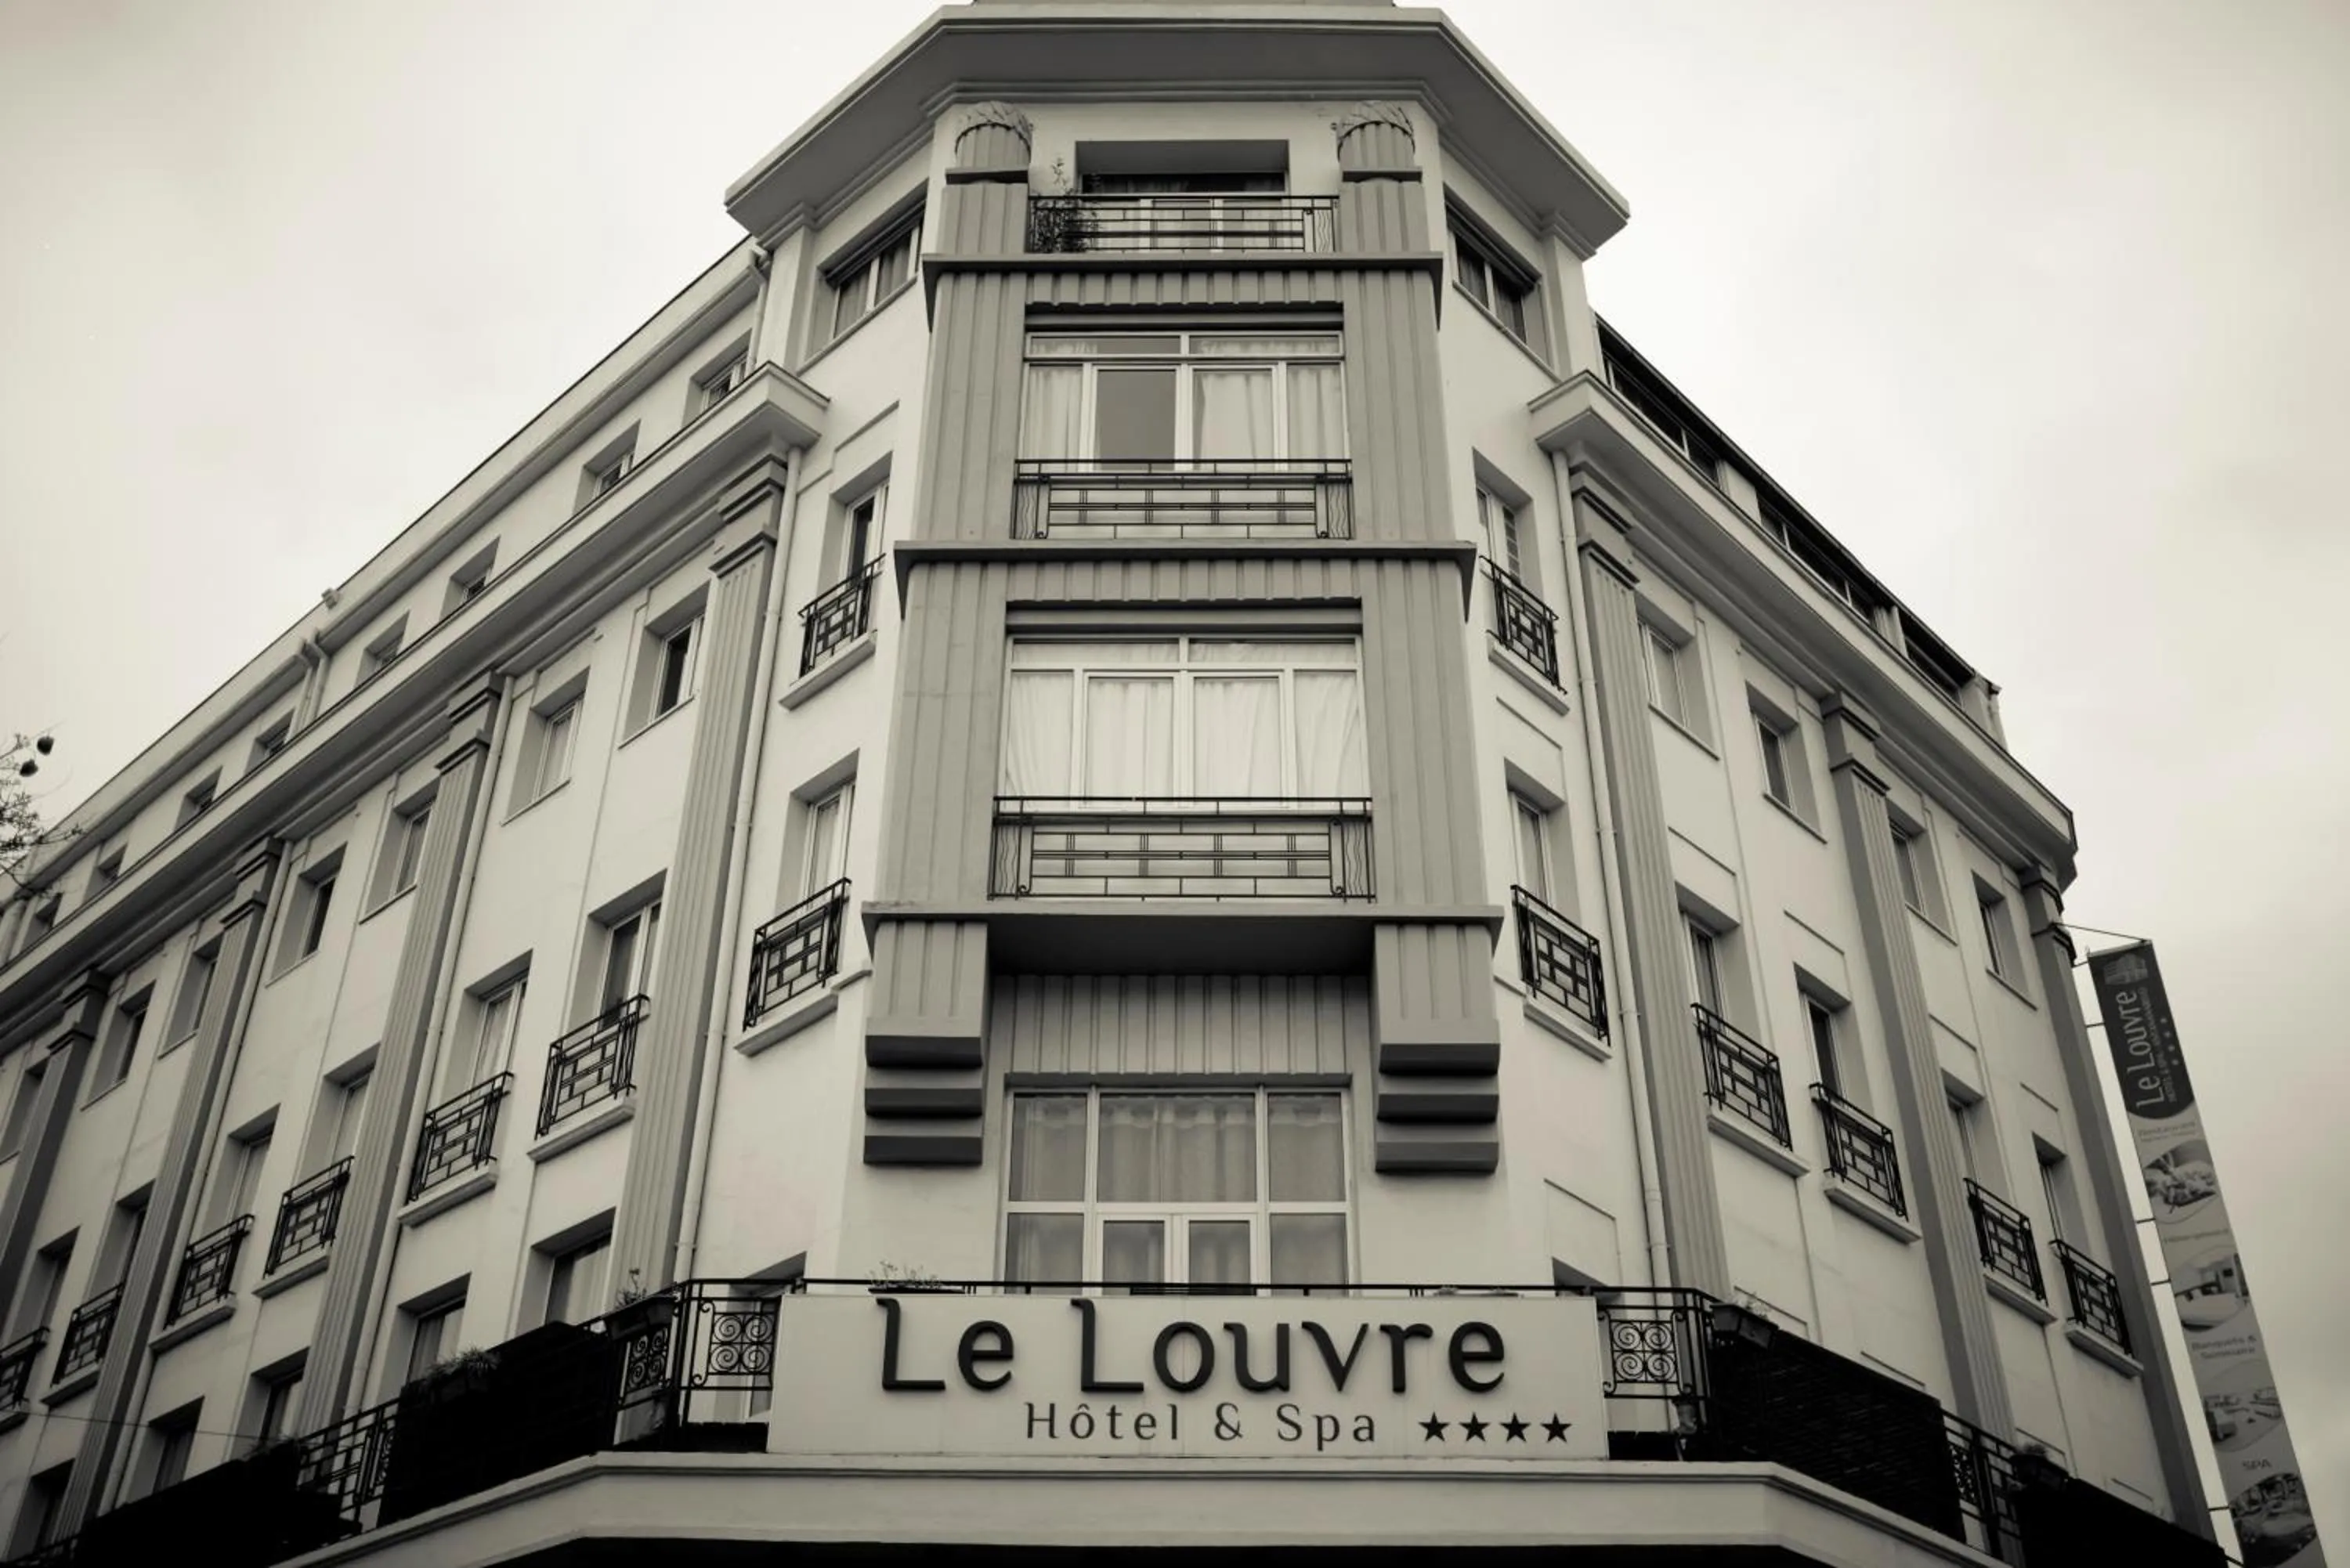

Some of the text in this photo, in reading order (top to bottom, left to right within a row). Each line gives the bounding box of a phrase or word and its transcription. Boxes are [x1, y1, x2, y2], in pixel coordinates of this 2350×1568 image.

[2116, 989, 2156, 1074] Louvre
[2136, 1074, 2164, 1108] Le
[876, 1297, 1505, 1395] Le Louvre
[1025, 1402, 1376, 1452] Hôtel & Spa
